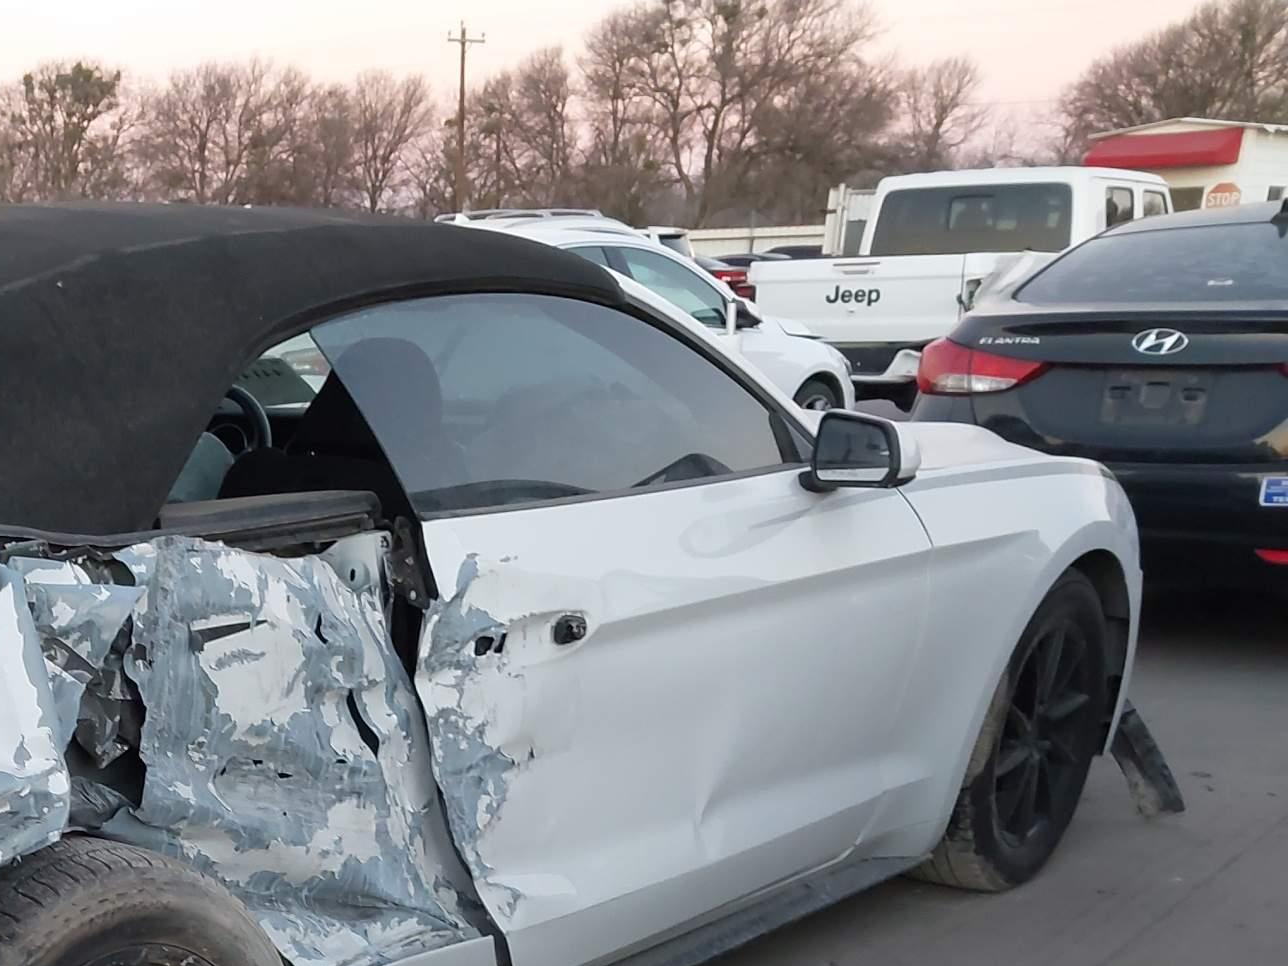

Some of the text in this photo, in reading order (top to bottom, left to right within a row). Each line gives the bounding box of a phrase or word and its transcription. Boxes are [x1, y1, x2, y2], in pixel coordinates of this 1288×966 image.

[1207, 192, 1241, 207] STOP
[825, 285, 881, 307] Jeep
[978, 336, 1041, 345] ELANTRA
